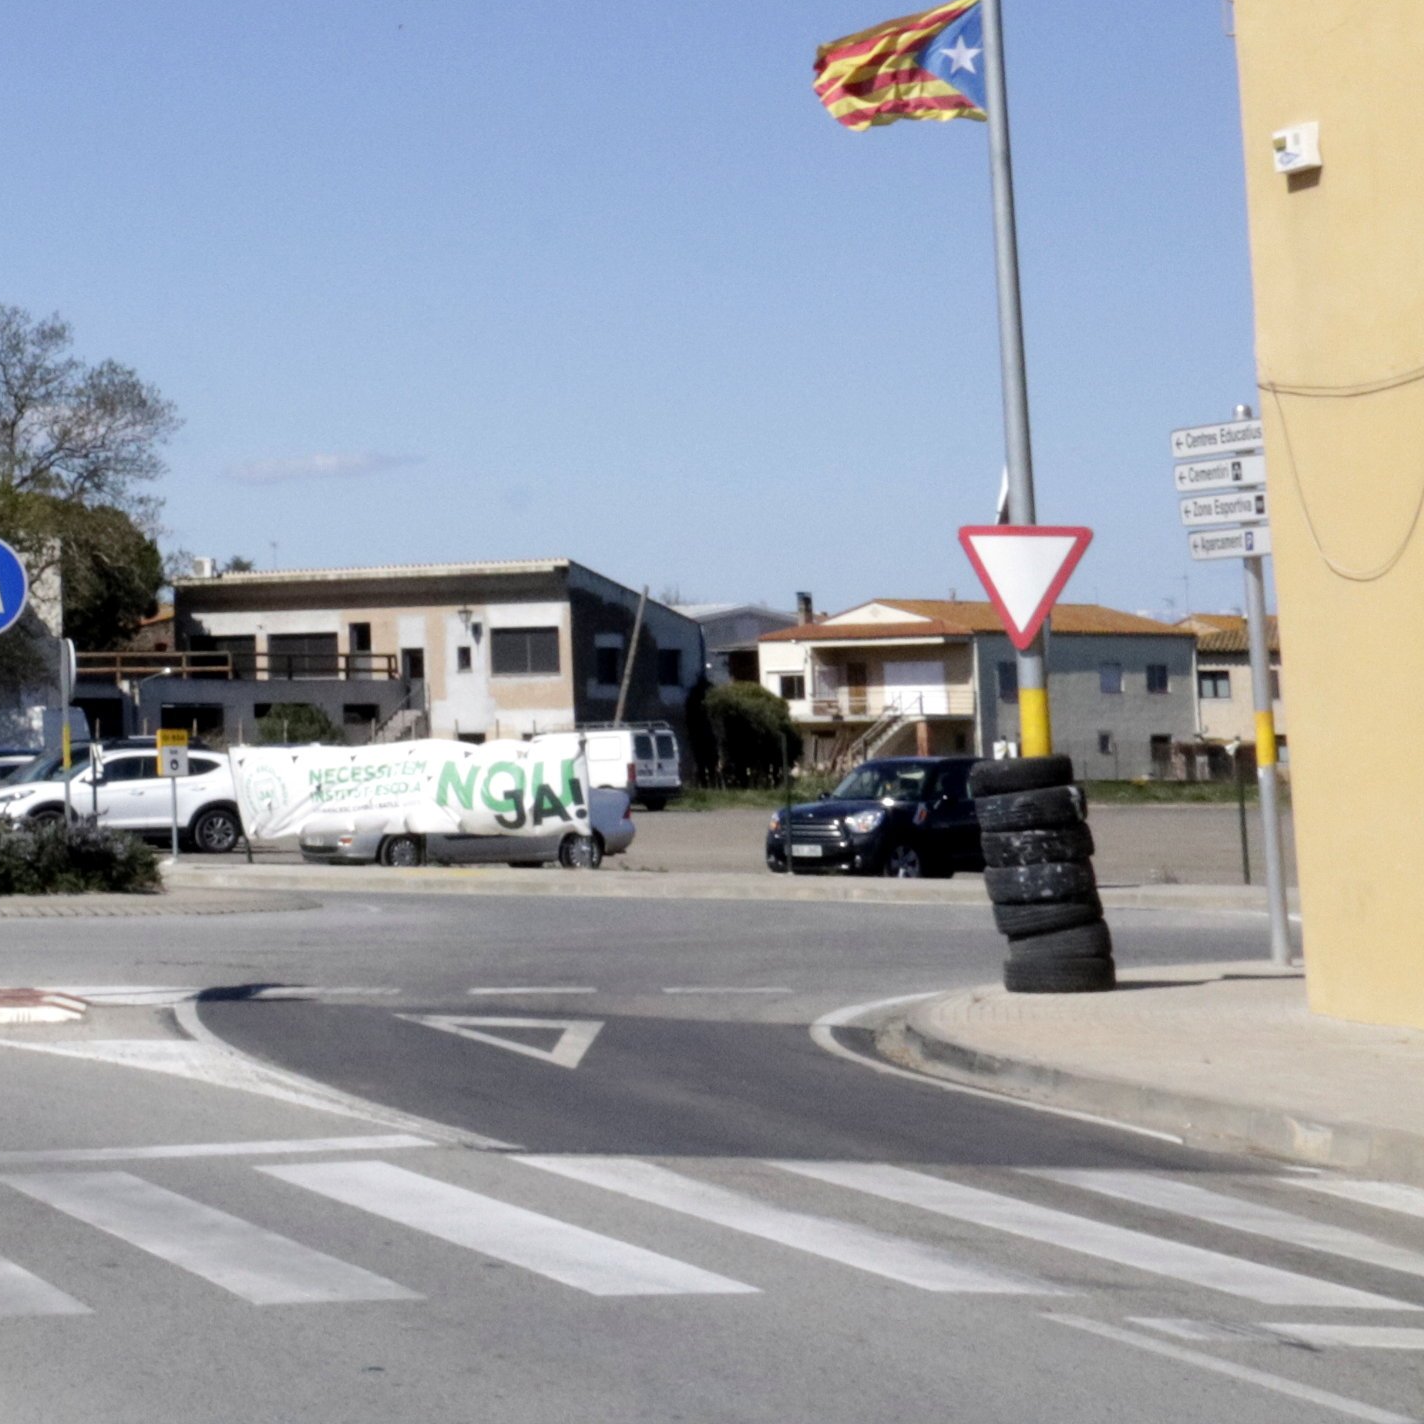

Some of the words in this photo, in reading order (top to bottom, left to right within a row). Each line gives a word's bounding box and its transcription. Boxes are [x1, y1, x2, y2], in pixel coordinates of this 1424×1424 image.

[1185, 432, 1218, 449] Centres
[1193, 501, 1212, 517] Zona
[436, 758, 574, 812] NOU
[495, 778, 587, 829] JA!
